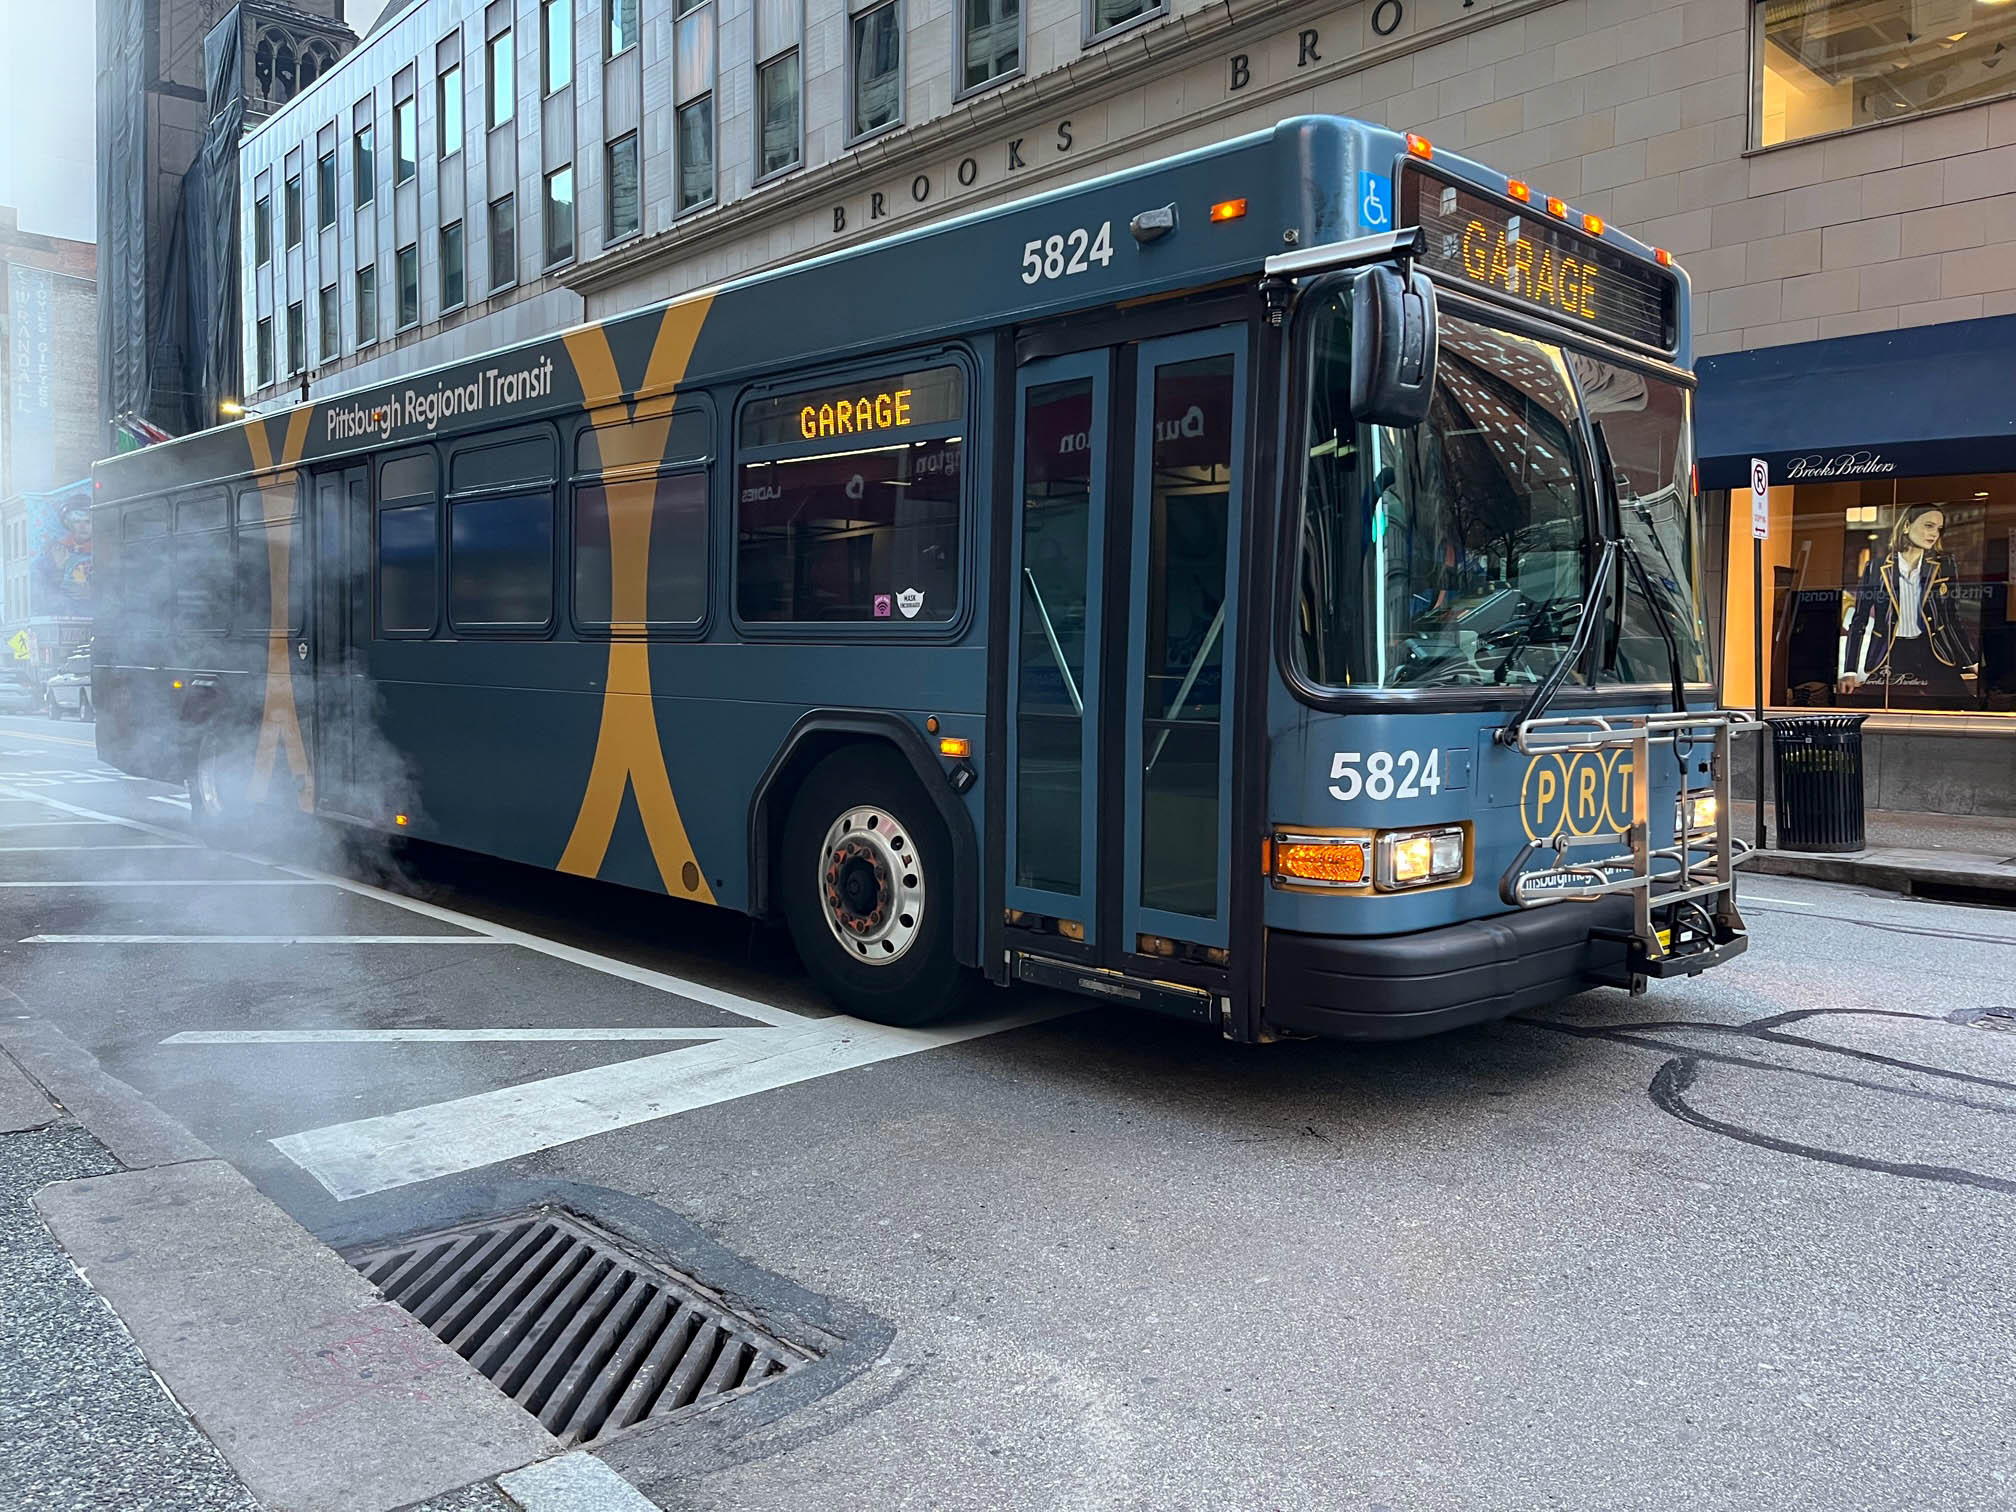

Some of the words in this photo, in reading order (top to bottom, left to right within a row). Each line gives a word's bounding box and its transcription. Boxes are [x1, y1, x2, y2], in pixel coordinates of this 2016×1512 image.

[832, 120, 1072, 233] BROOKS
[1230, 0, 1474, 90] BRO
[1021, 221, 1113, 285] 5824
[1462, 220, 1598, 319] GARAGE
[327, 394, 400, 439] Pittsburgh
[405, 371, 483, 430] Regional
[486, 354, 553, 407] Transit
[801, 389, 912, 438] GARAGE
[1787, 454, 1836, 478] Brooks
[1835, 450, 1897, 476] Brothers
[1328, 748, 1441, 801] 5824
[1536, 763, 1634, 824] PRT
